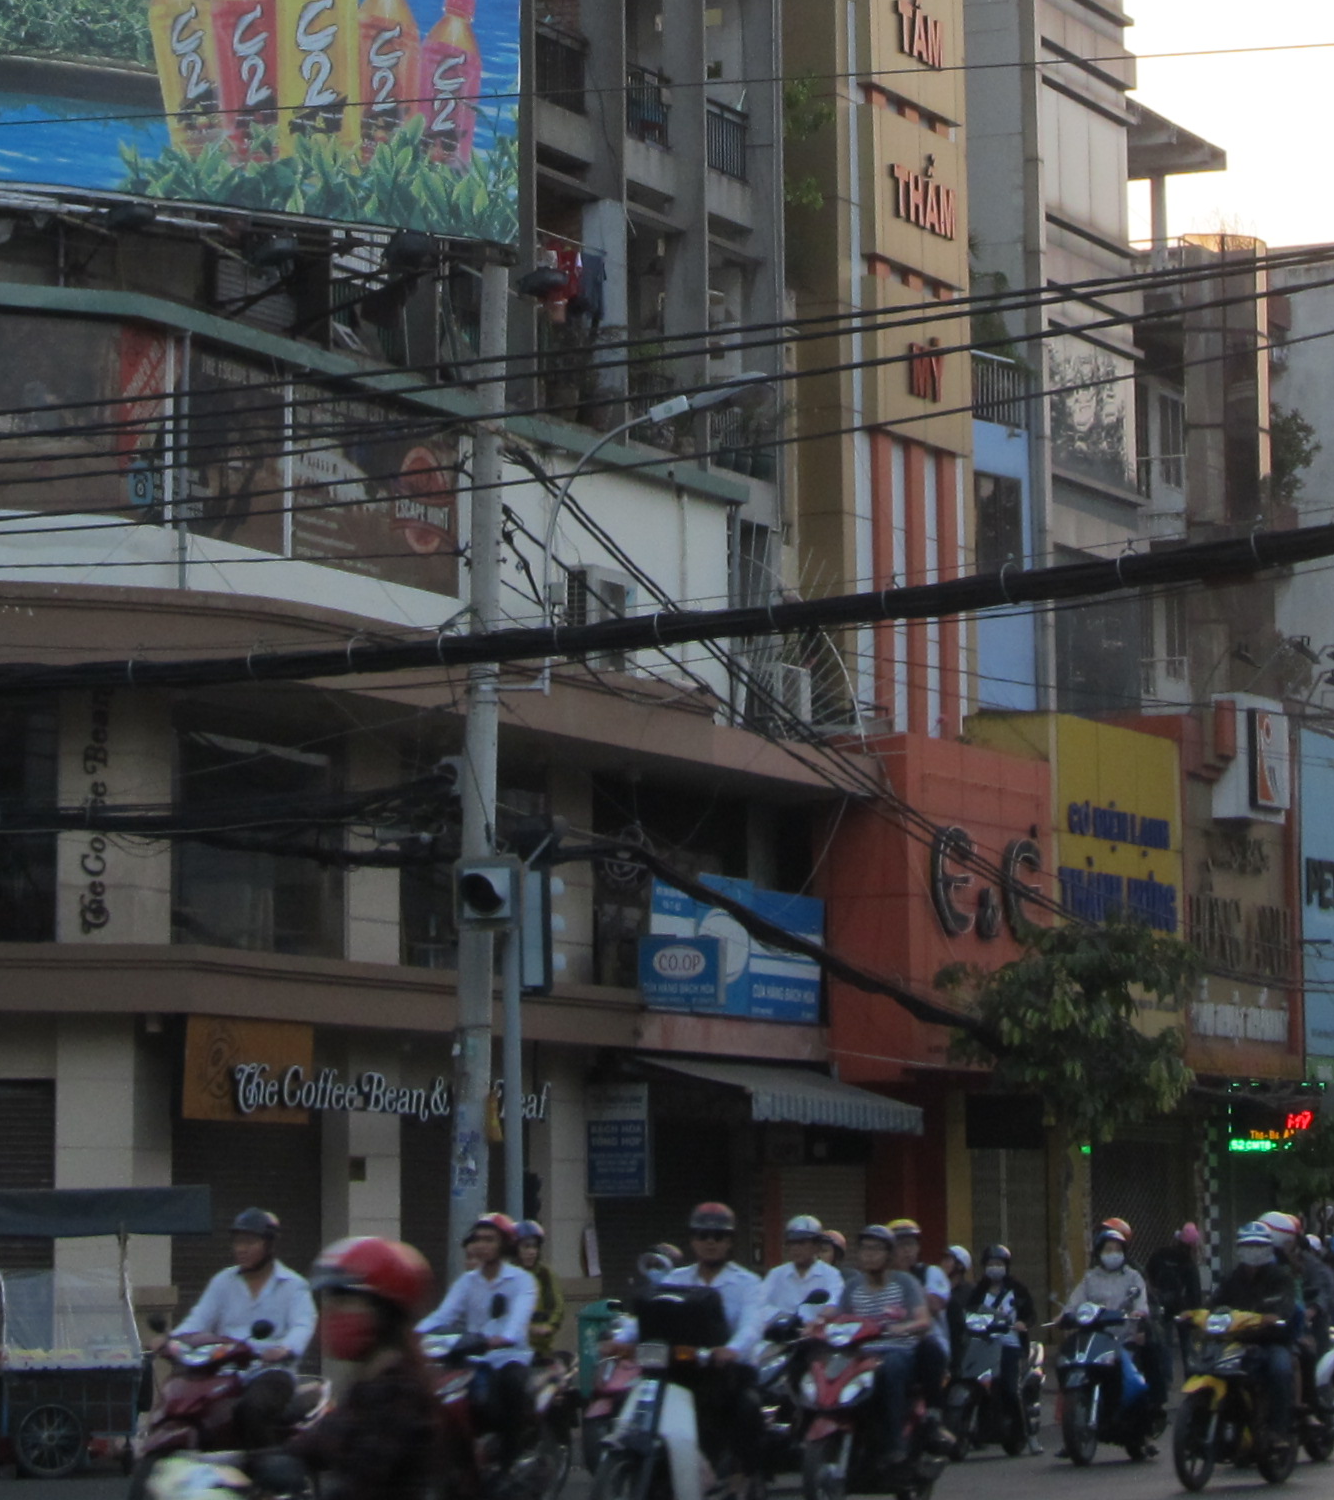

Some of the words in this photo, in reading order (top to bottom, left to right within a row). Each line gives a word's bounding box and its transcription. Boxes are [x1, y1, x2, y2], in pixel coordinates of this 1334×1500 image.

[889, 153, 956, 241] THẨM
[908, 337, 944, 402] MỸ
[658, 954, 701, 972] CO.OP
[234, 1062, 278, 1113] The
[283, 1064, 358, 1110] Coffee
[362, 1071, 428, 1121] Bean
[431, 1077, 450, 1115] &
